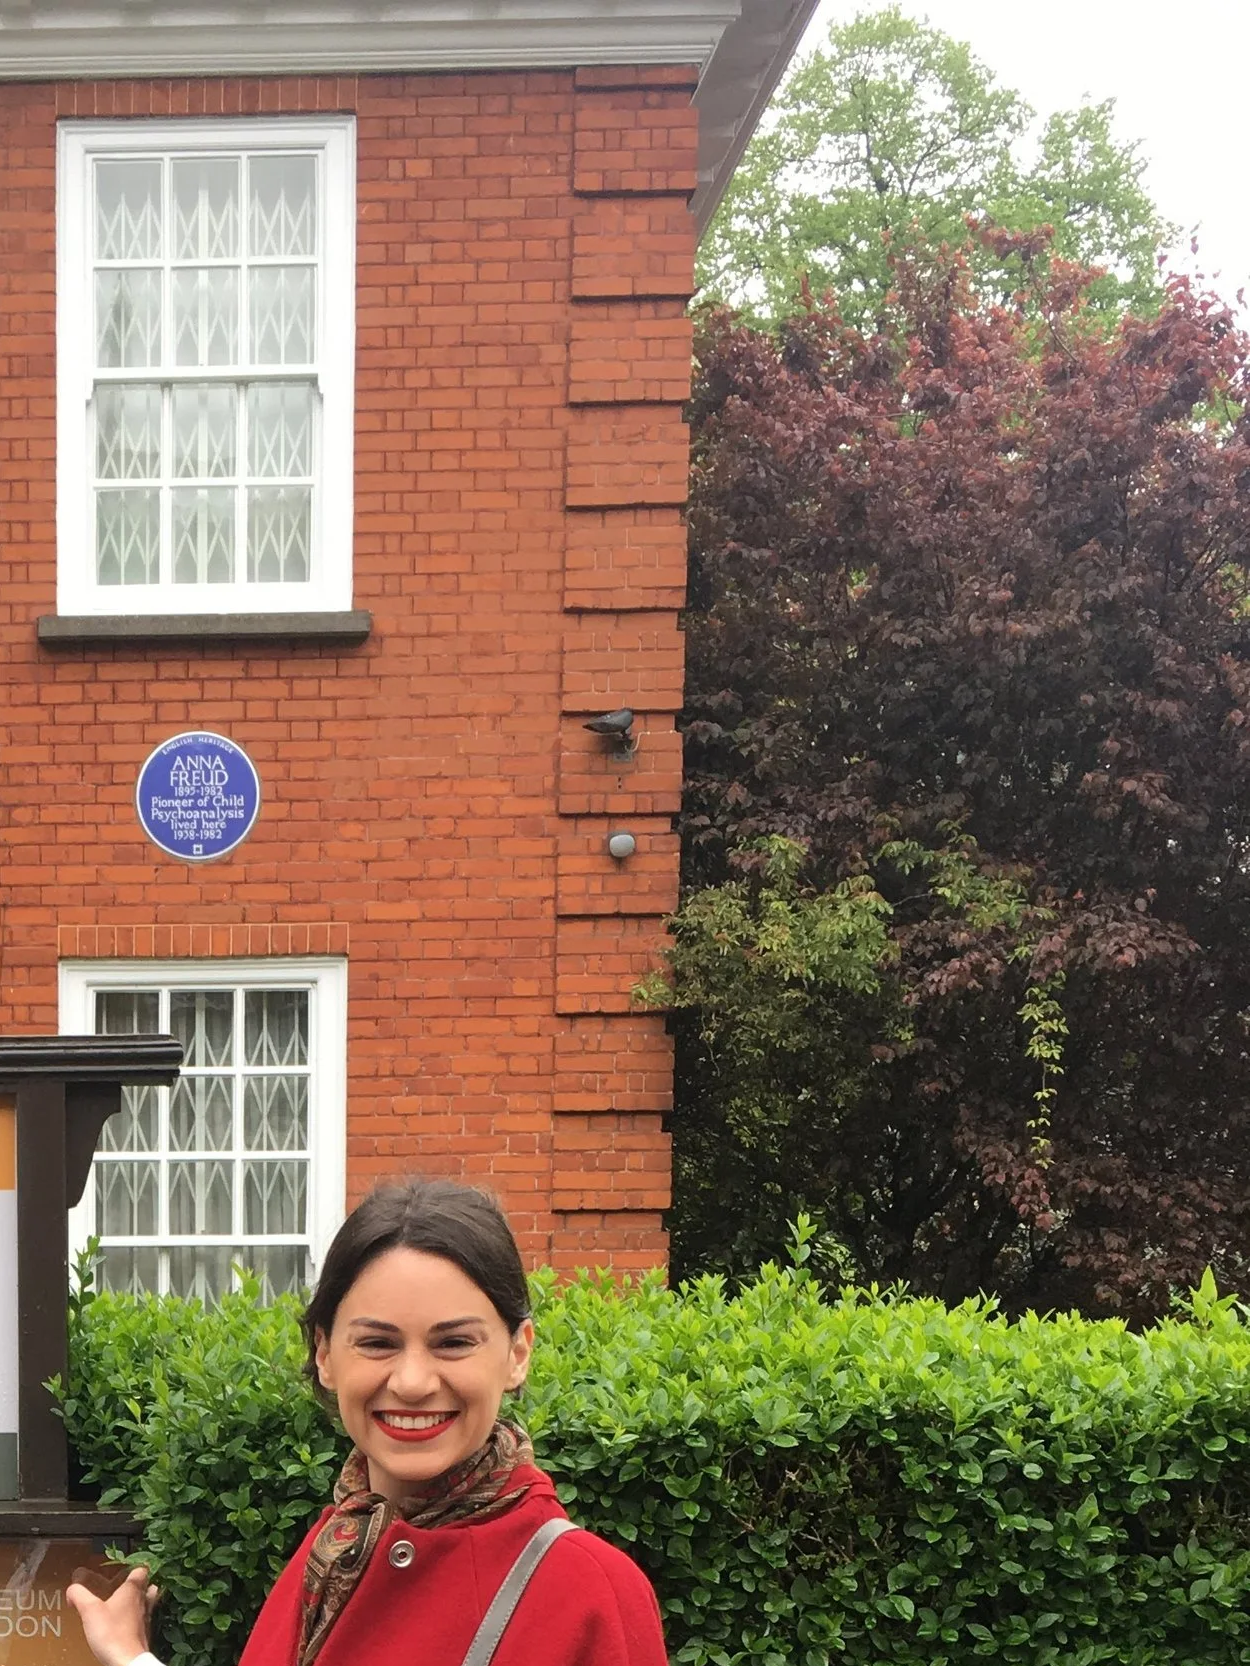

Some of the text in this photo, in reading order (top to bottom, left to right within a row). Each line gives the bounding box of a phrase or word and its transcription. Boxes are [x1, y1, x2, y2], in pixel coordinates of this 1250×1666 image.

[161, 738, 234, 755] ENGLISH HERITAGE
[173, 755, 225, 770] ANNA
[170, 771, 229, 786] FREUD
[174, 787, 222, 796] 1895-1982
[152, 795, 244, 806] Pioneer of Child
[152, 807, 244, 822] Psychoanalysis
[171, 820, 226, 829] lived here
[174, 830, 222, 839] 1938-1982
